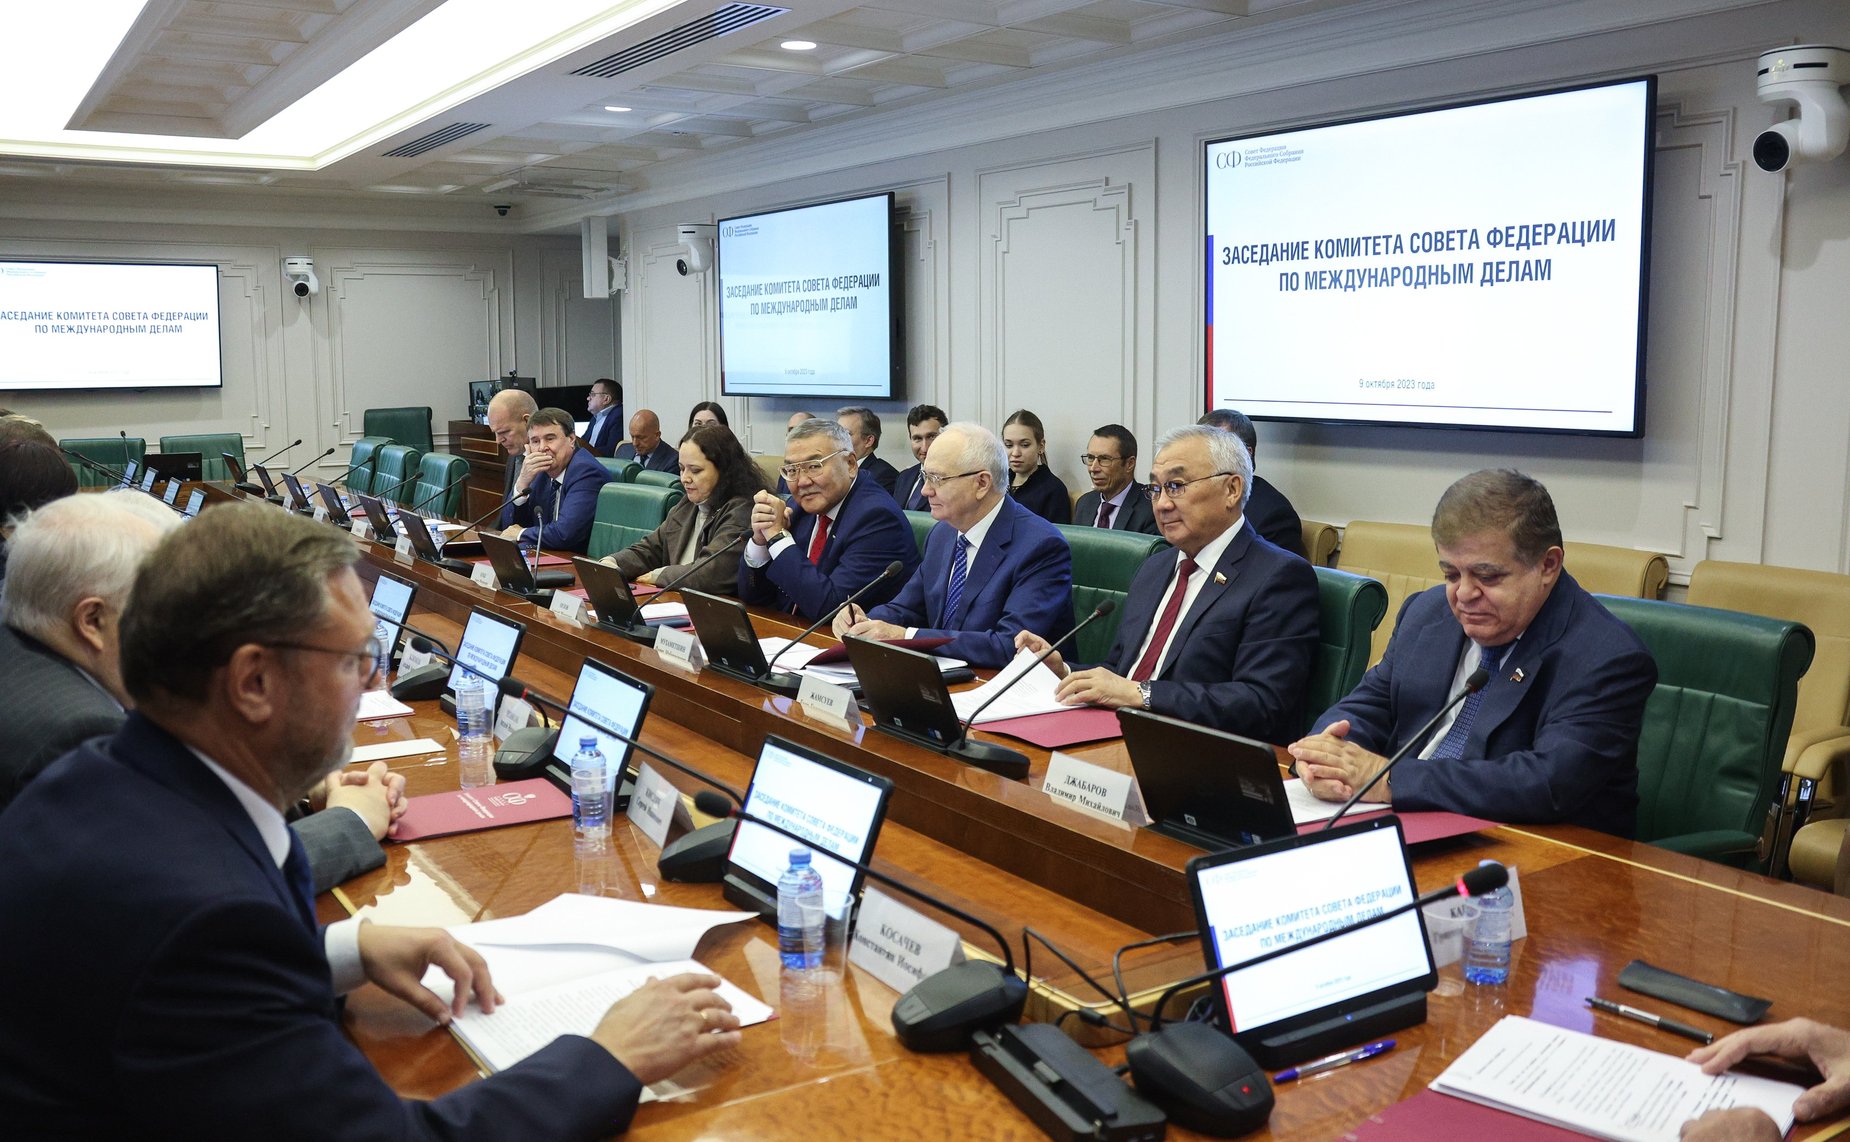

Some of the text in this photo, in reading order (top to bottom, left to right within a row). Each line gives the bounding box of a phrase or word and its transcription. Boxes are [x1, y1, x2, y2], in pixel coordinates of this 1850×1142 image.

[1216, 150, 1242, 169] СФ
[1222, 218, 1617, 266] ЗАСЕДАНИЕ КОМИТЕТА СОВЕТА ФЕДЕРАЦИИ
[726, 273, 881, 299] ЗАСЕДАНИЕ КОМИТЕТА СОВЕТА ФЕДЕРАЦИИ
[1279, 257, 1552, 292] ПО МЕЖДУНАРОДНЫМ ДЕЛАМ
[0, 310, 209, 322] АСЕДАНИЕ КОМИТЕТА СОВЕТА ФЕДЕРАЦИИ
[750, 295, 858, 316] ПО МЕЖДУНАРОДНЫМ ДЕЛАМ
[35, 324, 183, 335] ПО МЕЖДУНАРОДНЫМ ДЕЛАМ
[1358, 378, 1435, 390] 9 октября 2023 года
[1044, 782, 1077, 802] Владимир
[1079, 795, 1121, 818] Михайлович
[1063, 774, 1108, 798] ДЖАБАРОВ
[1222, 884, 1402, 942] ЗАСЕДАНИЕ КОМИТЕТА СОВЕТА ФЕДЕРАЦИИ
[880, 923, 923, 956] КОСАЧЕВ
[1260, 935, 1273, 949] ПО
[1274, 914, 1355, 944] МЕЖДУНАРОДНЫМ
[853, 930, 924, 980] Константин Иосиф
